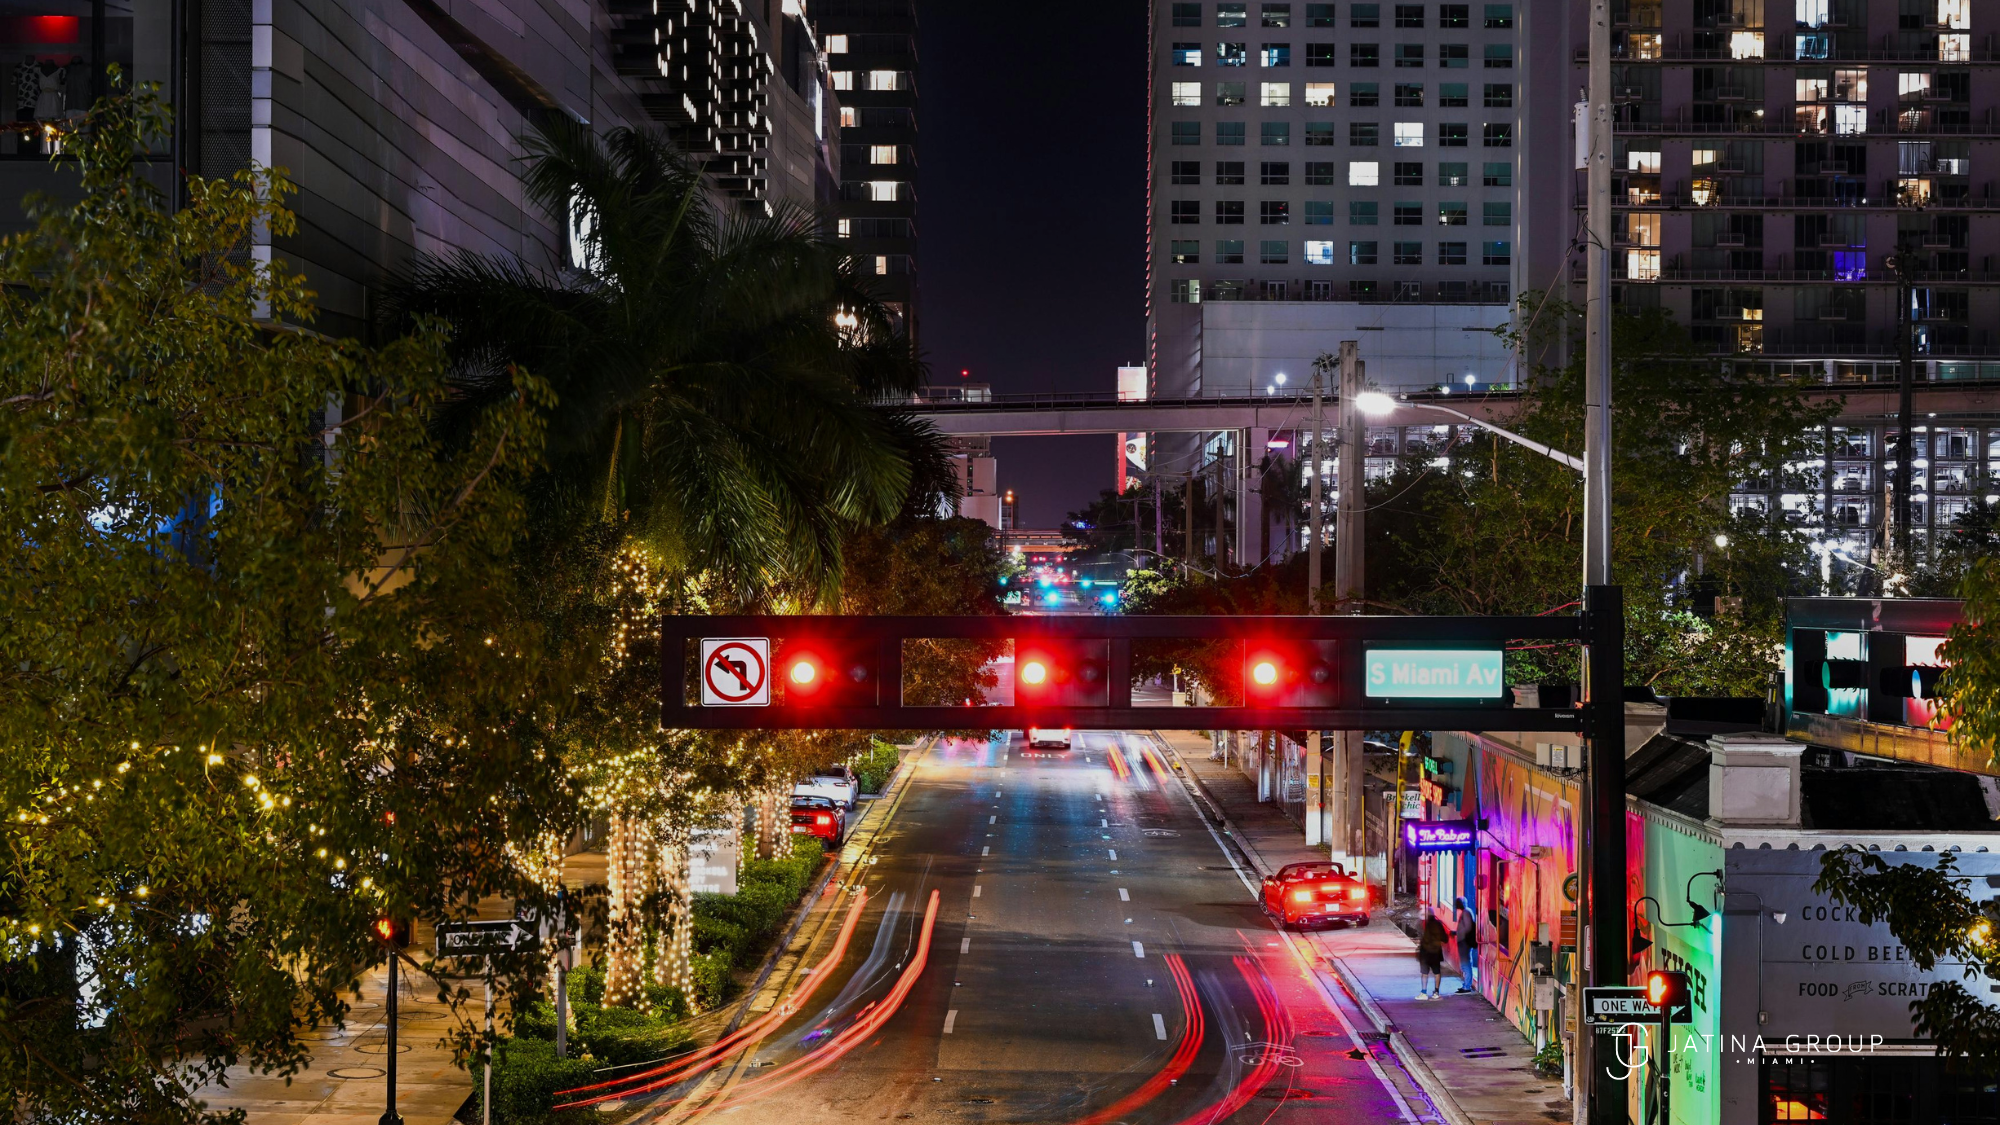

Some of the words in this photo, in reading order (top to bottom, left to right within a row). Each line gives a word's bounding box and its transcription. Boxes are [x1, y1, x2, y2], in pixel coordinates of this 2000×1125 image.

[1370, 663, 1386, 685] S
[1392, 662, 1460, 685] Miami
[1466, 663, 1498, 685] Av
[1386, 793, 1420, 802] Brkell
[1419, 829, 1436, 841] The
[1802, 906, 1885, 922] COCKA
[1802, 945, 1854, 960] COLD
[1799, 982, 1838, 996] FOOD
[1850, 984, 1865, 992] FROM
[1878, 982, 1928, 996] SCRAT
[1602, 1000, 1628, 1012] ONE
